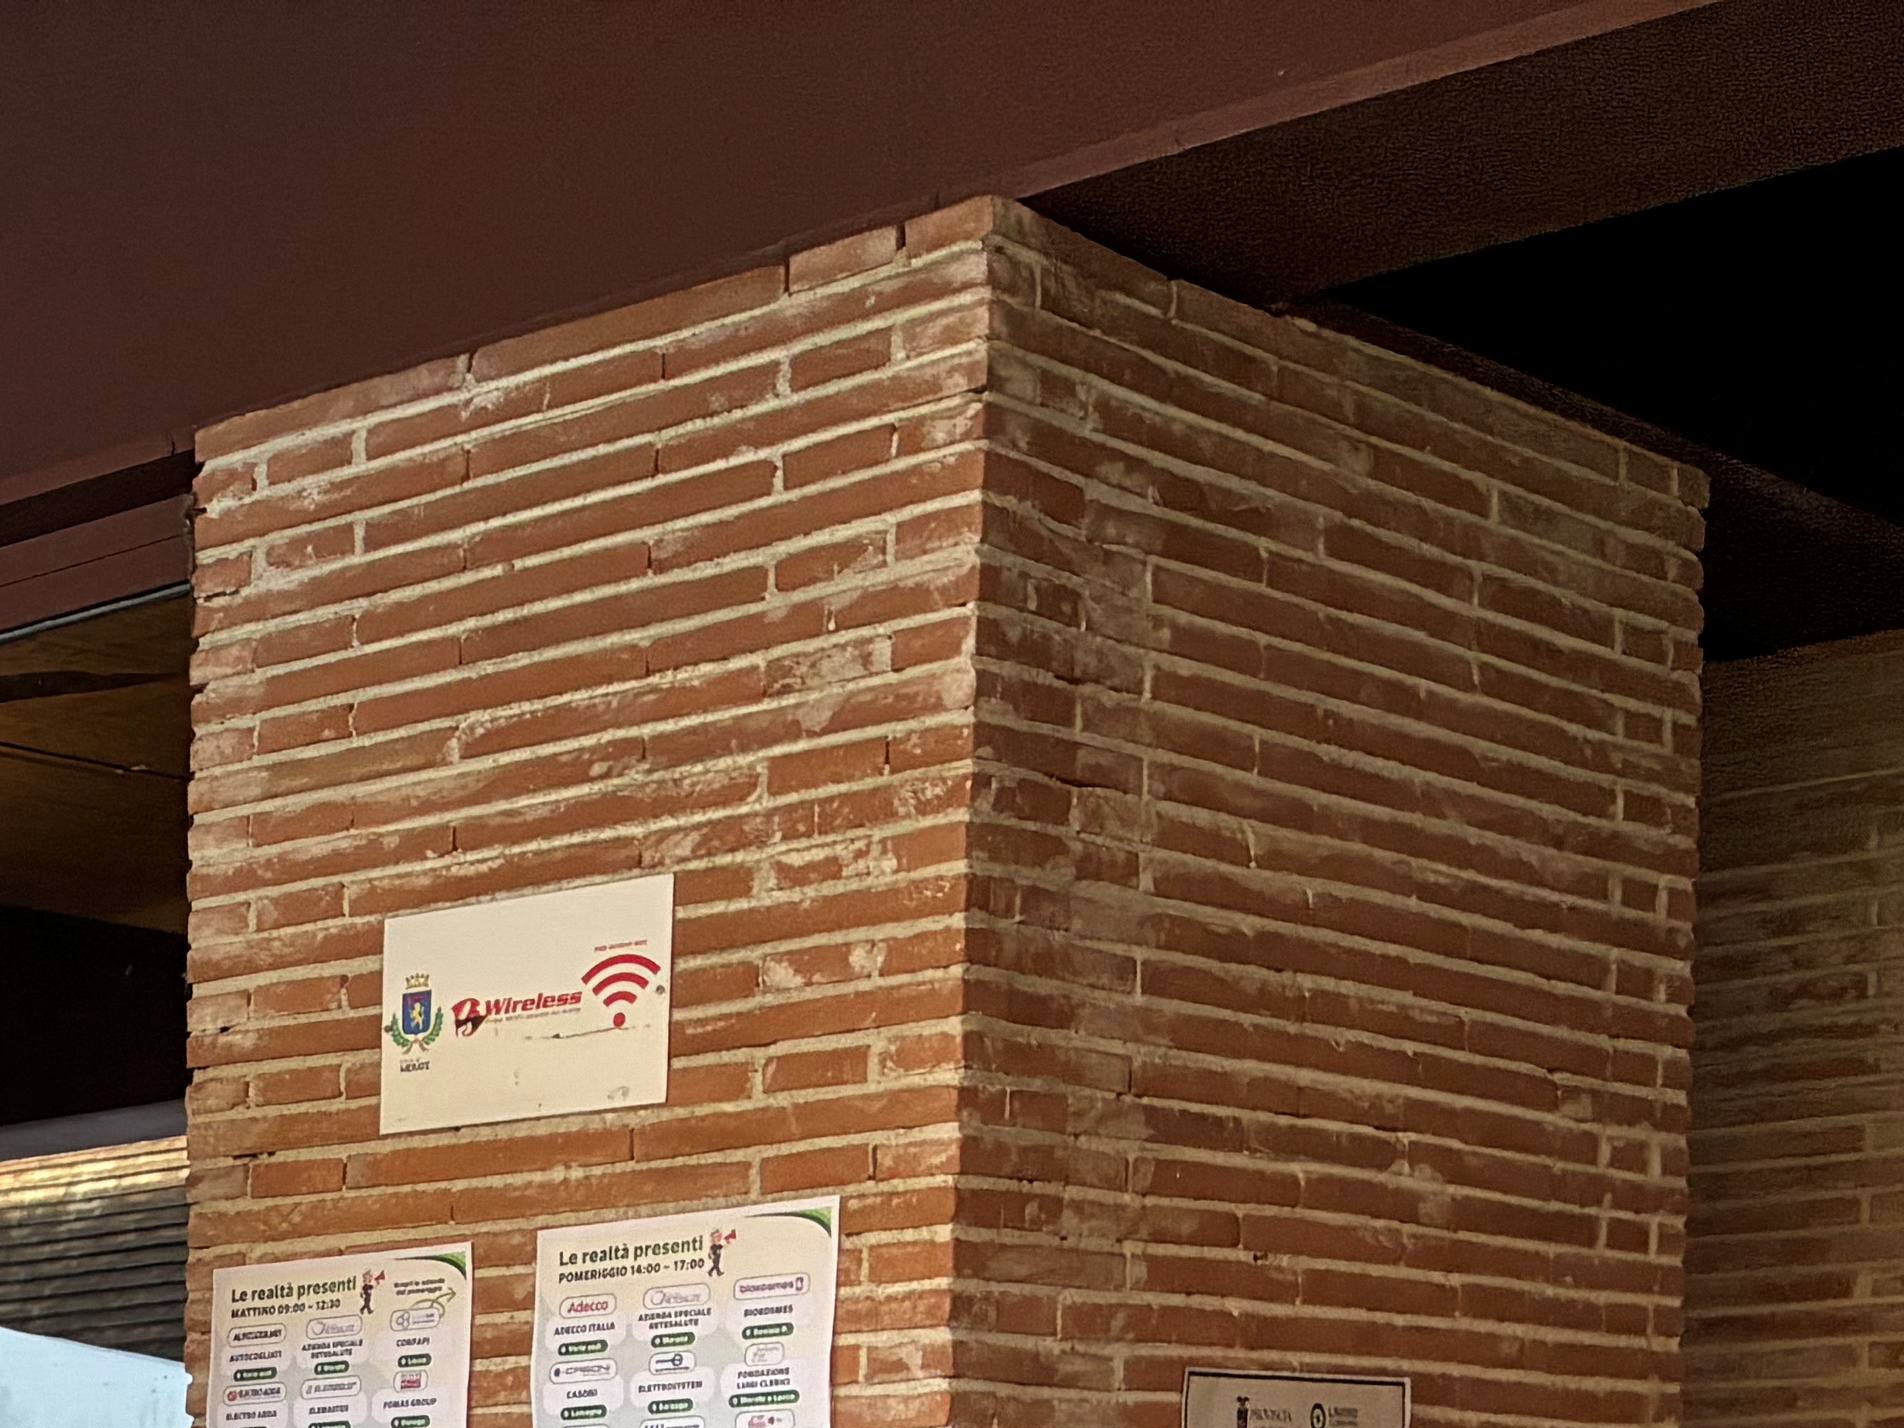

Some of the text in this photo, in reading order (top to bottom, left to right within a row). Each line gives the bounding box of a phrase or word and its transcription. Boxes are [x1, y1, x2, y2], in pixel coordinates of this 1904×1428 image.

[485, 991, 583, 1016] Wireless
[559, 1235, 704, 1266] Le realtà presenti
[558, 1267, 627, 1284] POMERIGGIO
[674, 1258, 705, 1272] 17:00
[231, 1275, 357, 1304] Le realtà presenti
[568, 1300, 609, 1314] Adecco
